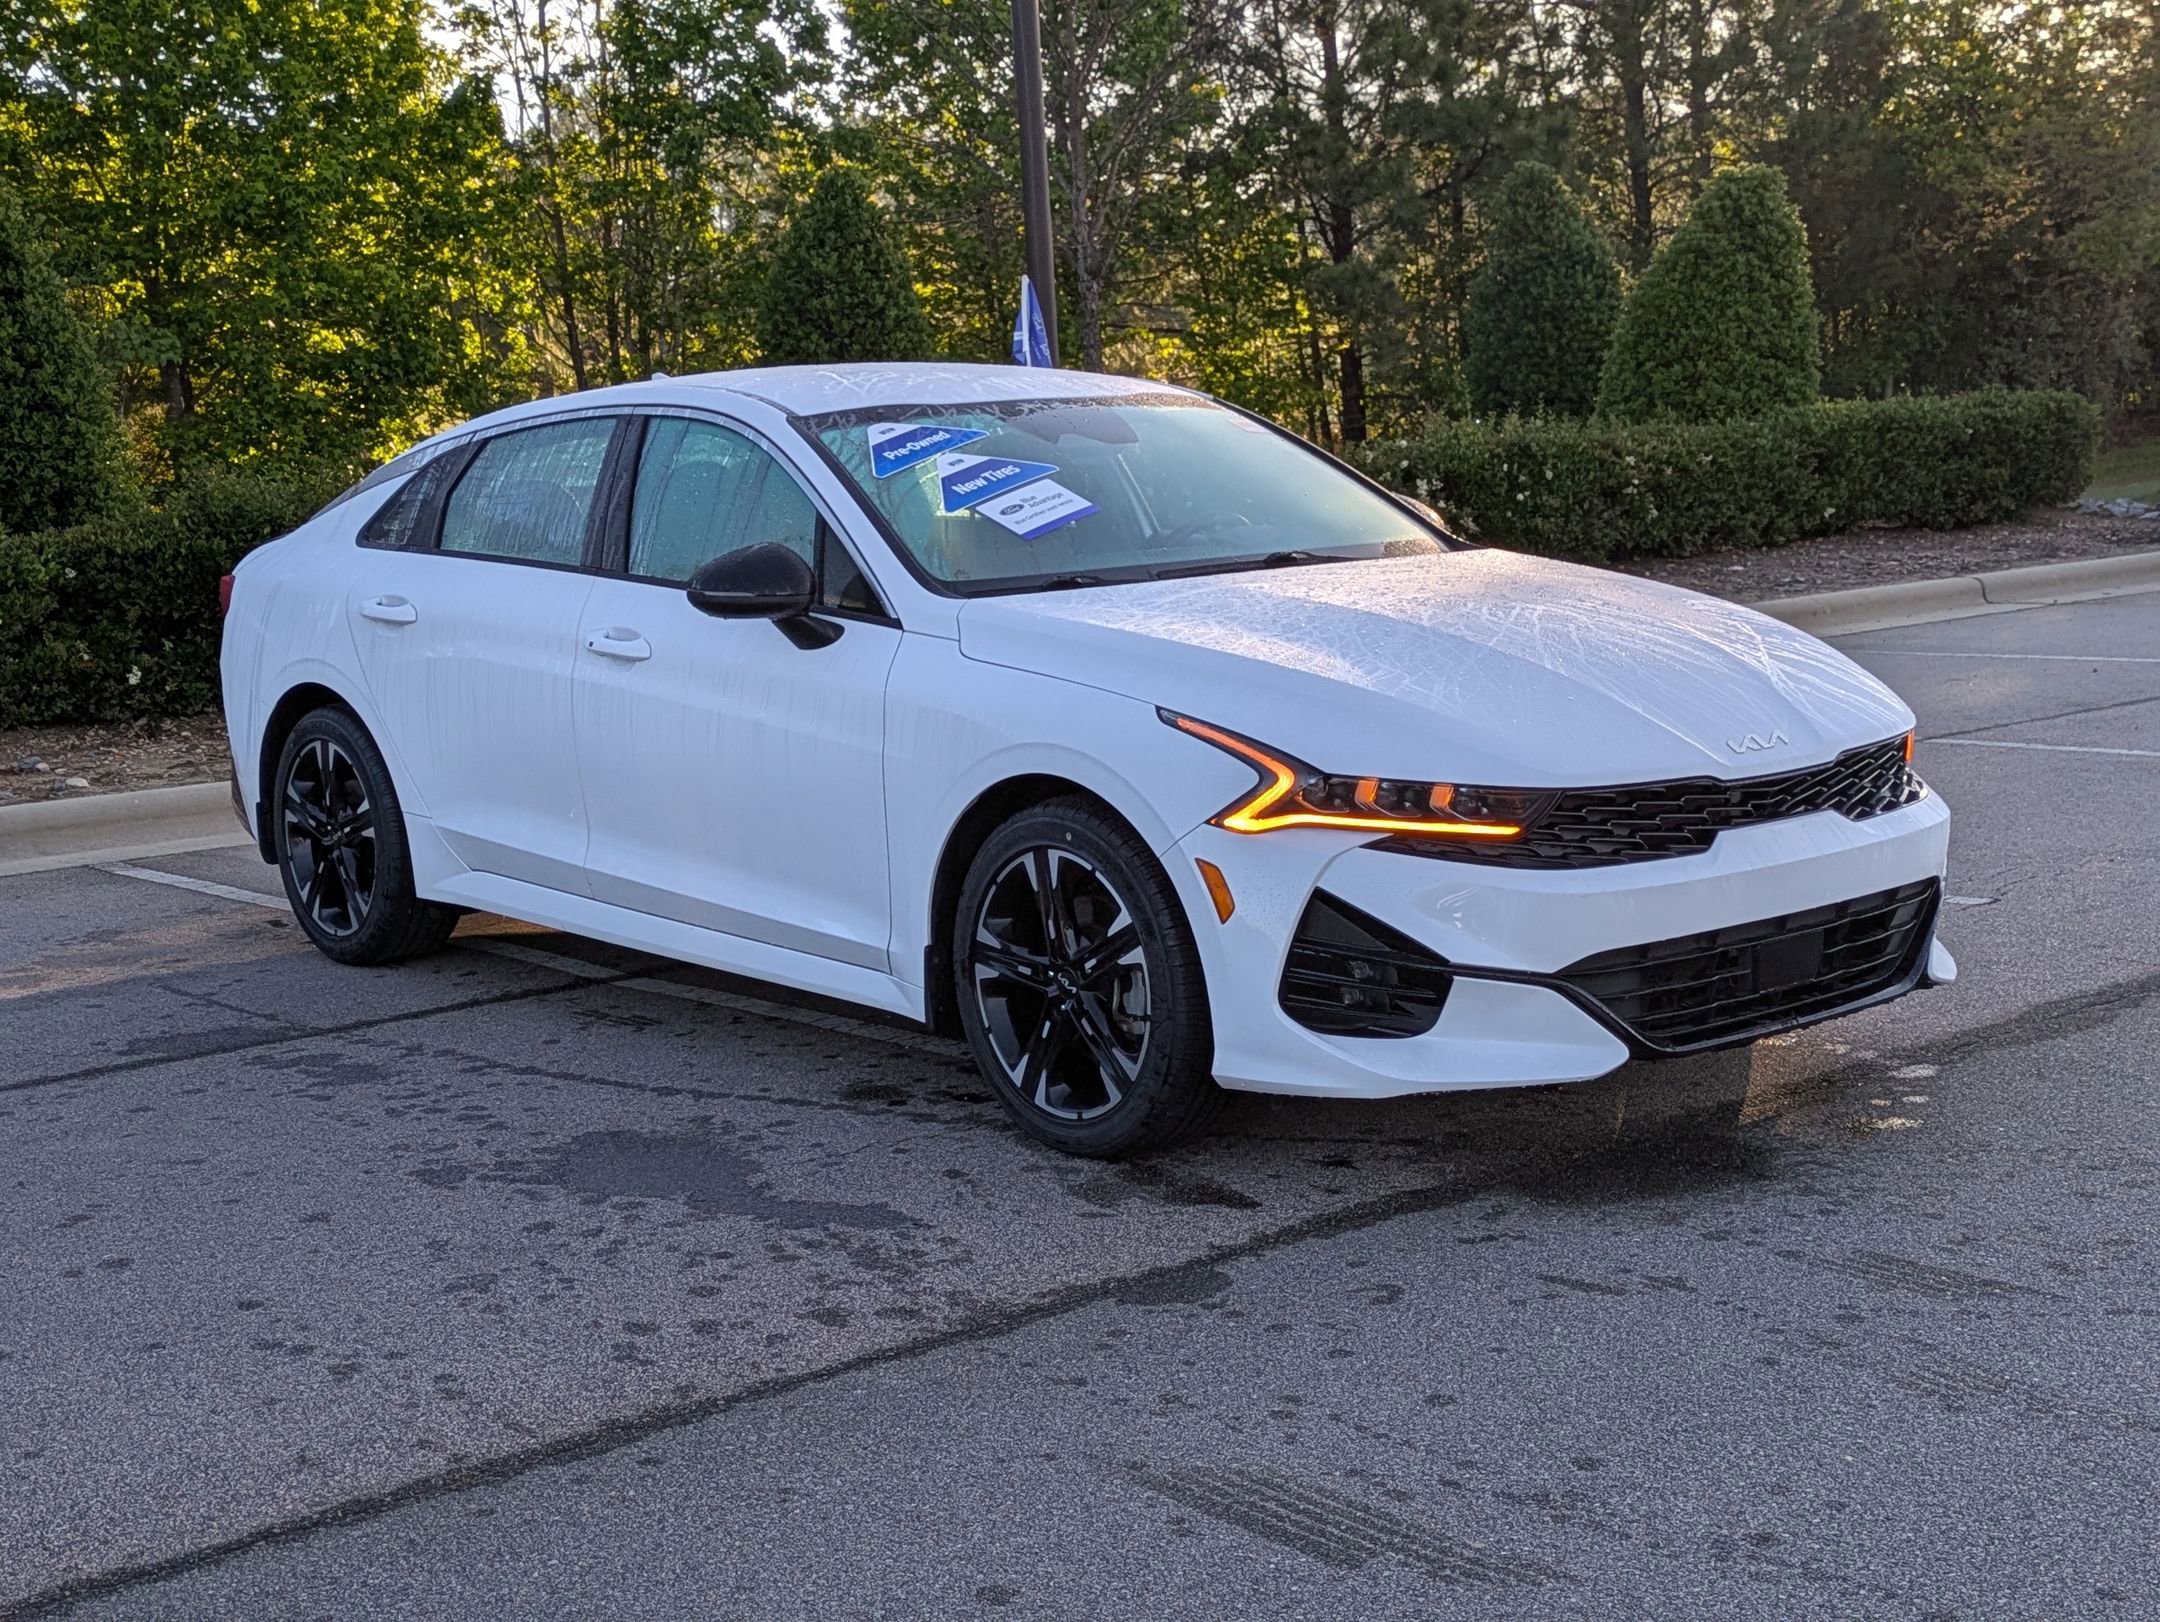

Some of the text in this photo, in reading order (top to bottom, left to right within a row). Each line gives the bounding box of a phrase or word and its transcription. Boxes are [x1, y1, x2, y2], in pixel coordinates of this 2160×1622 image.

[882, 430, 952, 460] Pre-Owned
[951, 464, 1022, 495] New Tires
[1726, 729, 1788, 754] KIA
